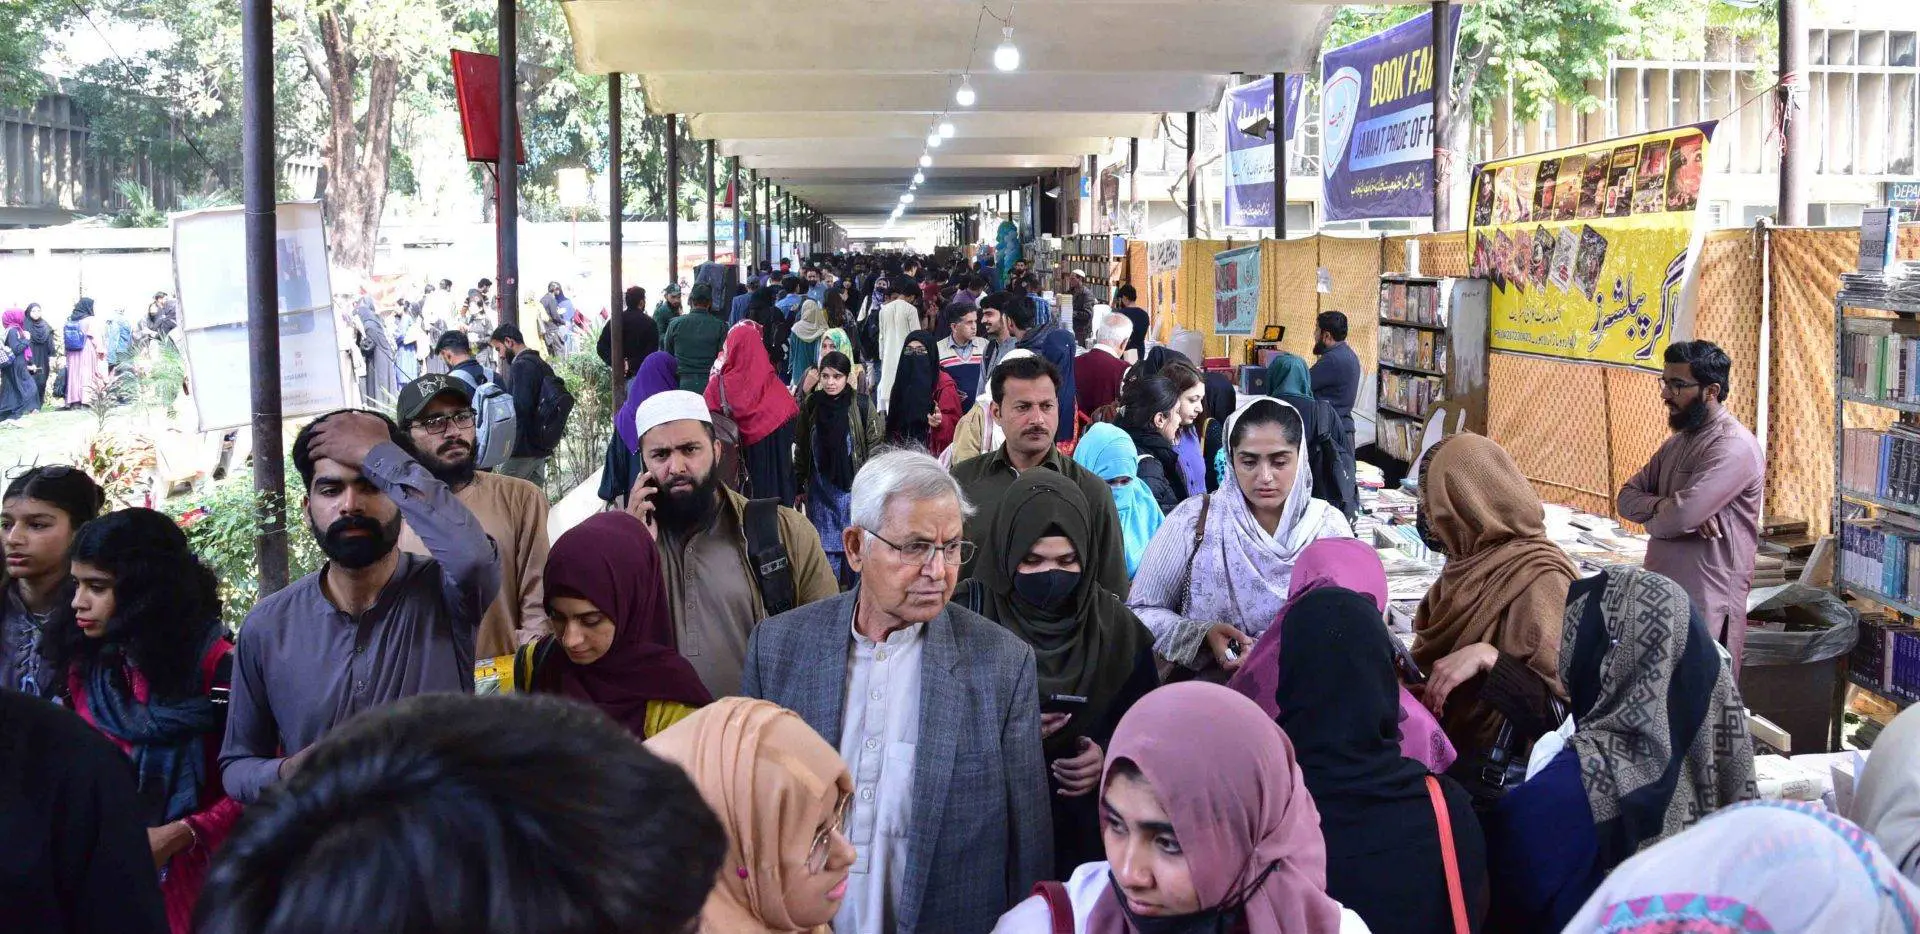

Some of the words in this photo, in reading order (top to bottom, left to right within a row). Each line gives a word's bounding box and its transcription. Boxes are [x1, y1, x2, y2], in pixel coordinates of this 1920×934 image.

[1370, 54, 1408, 107] BOOK
[1354, 127, 1387, 160] JAMIAT
[1387, 120, 1409, 153] PRIDE
[1410, 116, 1427, 149] OF
[1893, 183, 1920, 199] DEPA
[1588, 272, 1653, 352] پبلشرز
